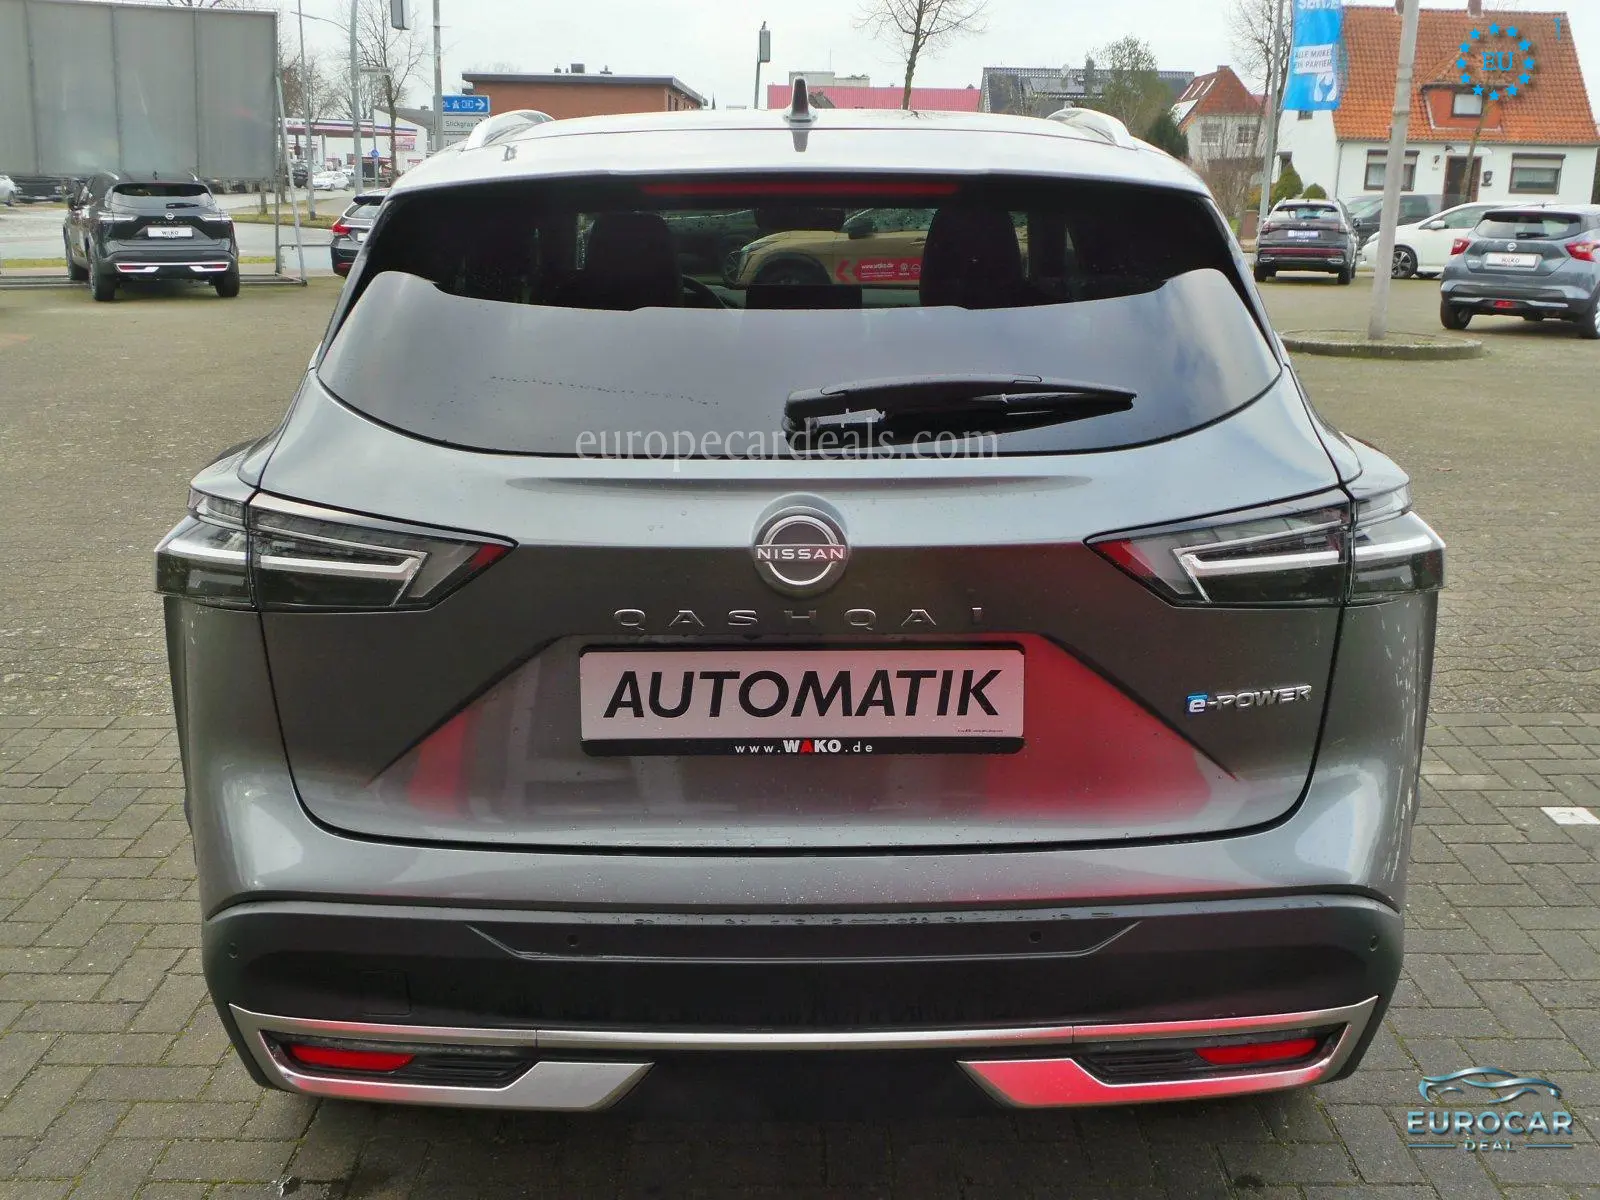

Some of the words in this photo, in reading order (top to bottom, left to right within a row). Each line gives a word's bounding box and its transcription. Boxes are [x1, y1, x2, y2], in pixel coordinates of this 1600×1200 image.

[757, 548, 844, 560] NISSAN
[613, 607, 983, 631] QASHQAI
[603, 668, 1004, 719] AUTOMATIK
[1187, 684, 1312, 713] e-POWER
[734, 738, 873, 754] www.WAKO.de
